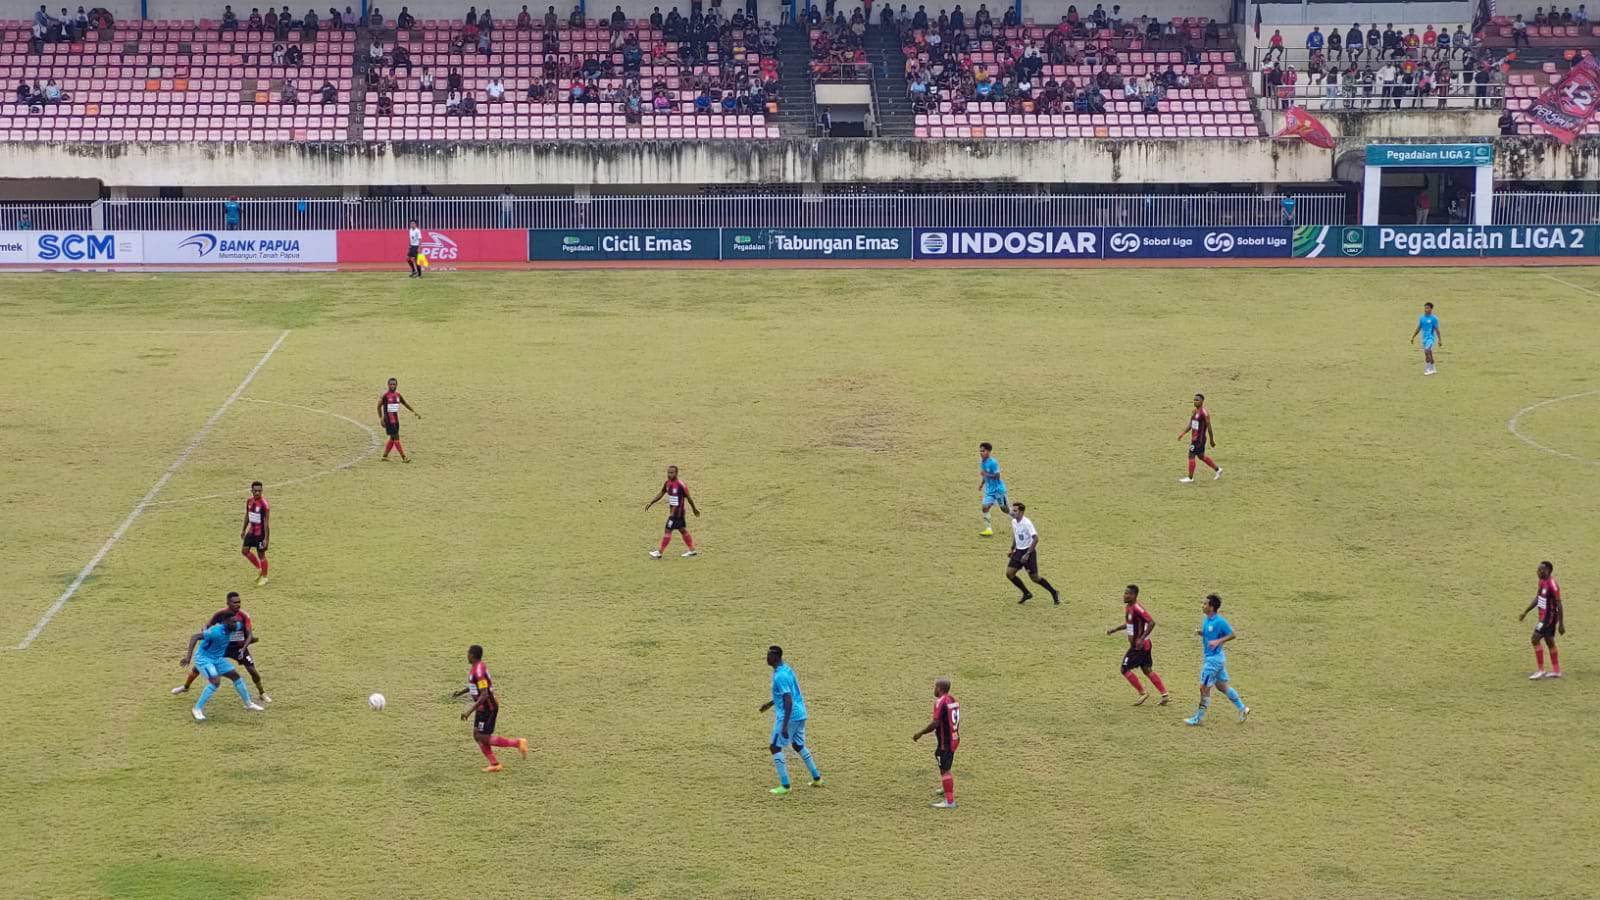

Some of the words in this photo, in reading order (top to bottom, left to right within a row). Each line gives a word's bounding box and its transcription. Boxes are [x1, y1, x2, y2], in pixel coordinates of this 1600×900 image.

[1563, 80, 1592, 111] 12
[1386, 150, 1437, 161] Pegadaian
[1440, 150, 1462, 160] LIGA
[1463, 150, 1472, 160] 2
[38, 234, 115, 260] SCM
[219, 240, 256, 251] BANK
[259, 240, 300, 251] PAPUA
[602, 236, 640, 251] Cicil
[645, 236, 692, 251] Emas
[734, 243, 766, 252] Pegadaian
[775, 235, 852, 254] Tabungan
[855, 235, 899, 250] Emas
[952, 231, 1096, 254] INDOSIAR
[1143, 237, 1170, 246] Sobat
[1173, 237, 1193, 248] Liga
[1237, 237, 1265, 246] Sobat
[1267, 237, 1287, 247] Liga
[1380, 228, 1503, 255] Pegadaian
[1511, 228, 1566, 249] LIGA
[1570, 228, 1584, 249] 2
[422, 247, 458, 259] PECS
[562, 244, 594, 252] Pegadaian
